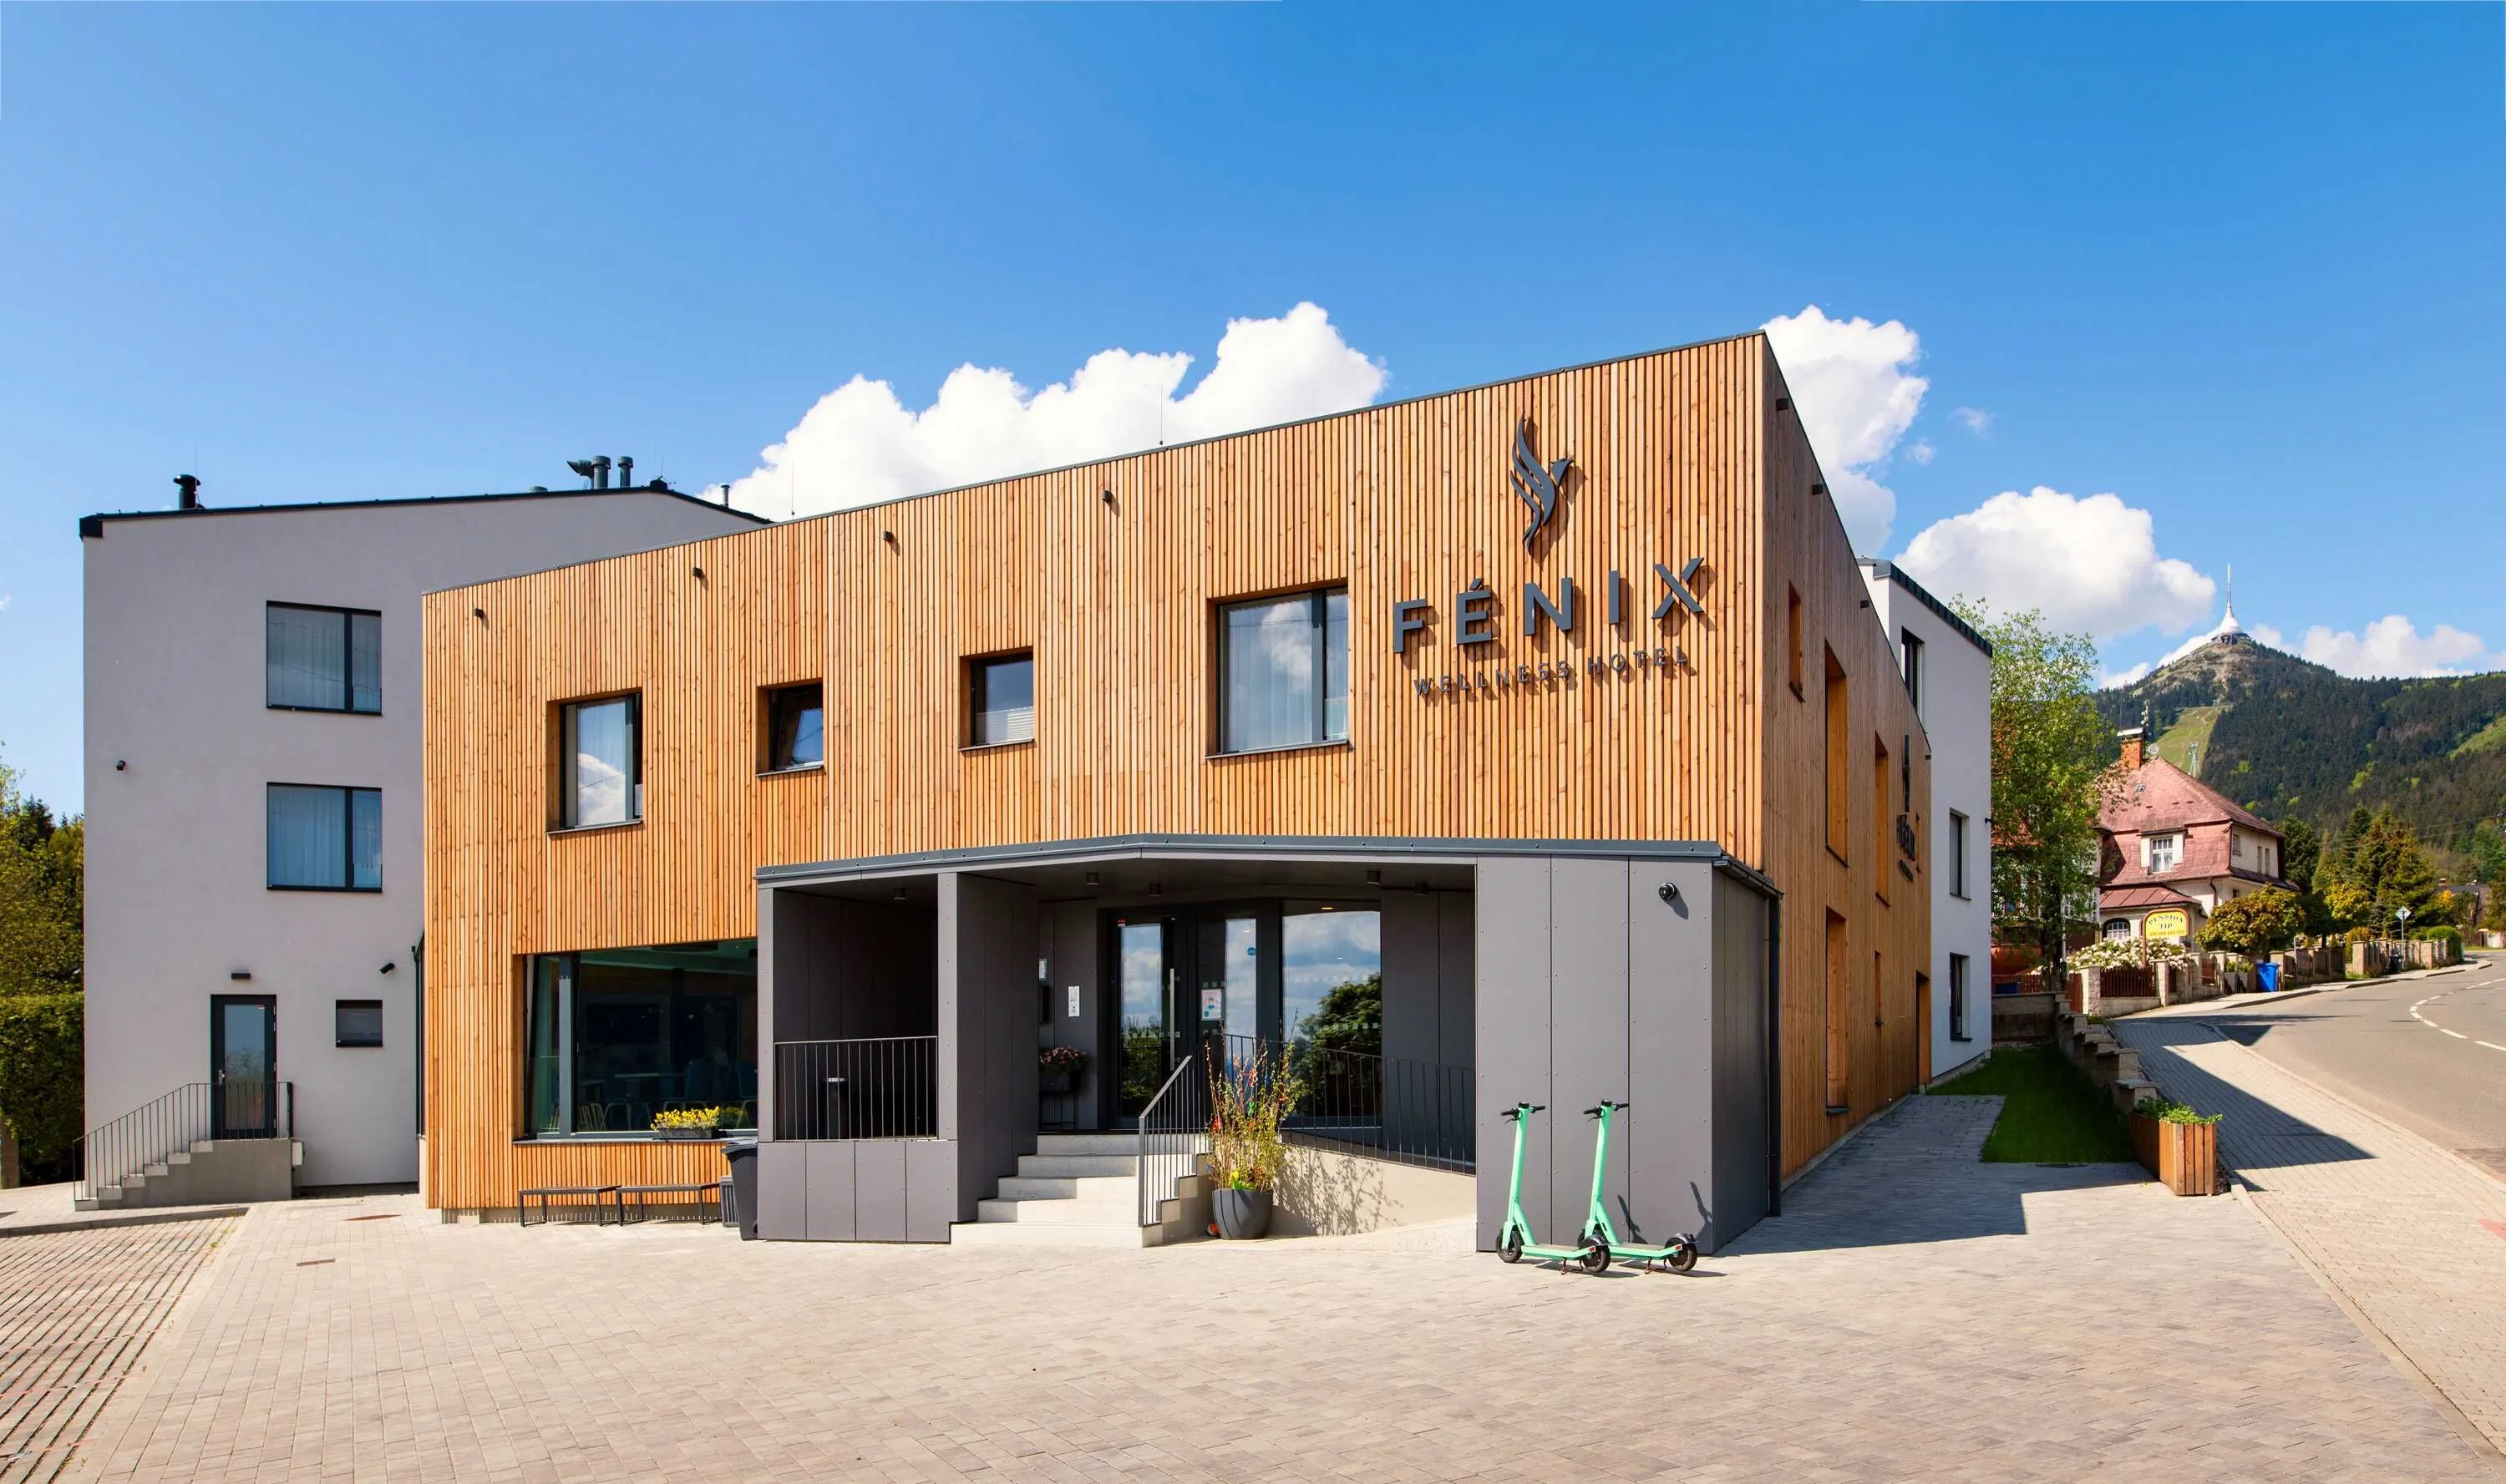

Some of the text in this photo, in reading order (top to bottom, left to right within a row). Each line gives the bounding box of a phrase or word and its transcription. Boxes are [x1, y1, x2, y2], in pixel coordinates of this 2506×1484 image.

[1393, 557, 1705, 654] FÉNIX
[1413, 645, 1687, 696] WELLNESS HOTEL
